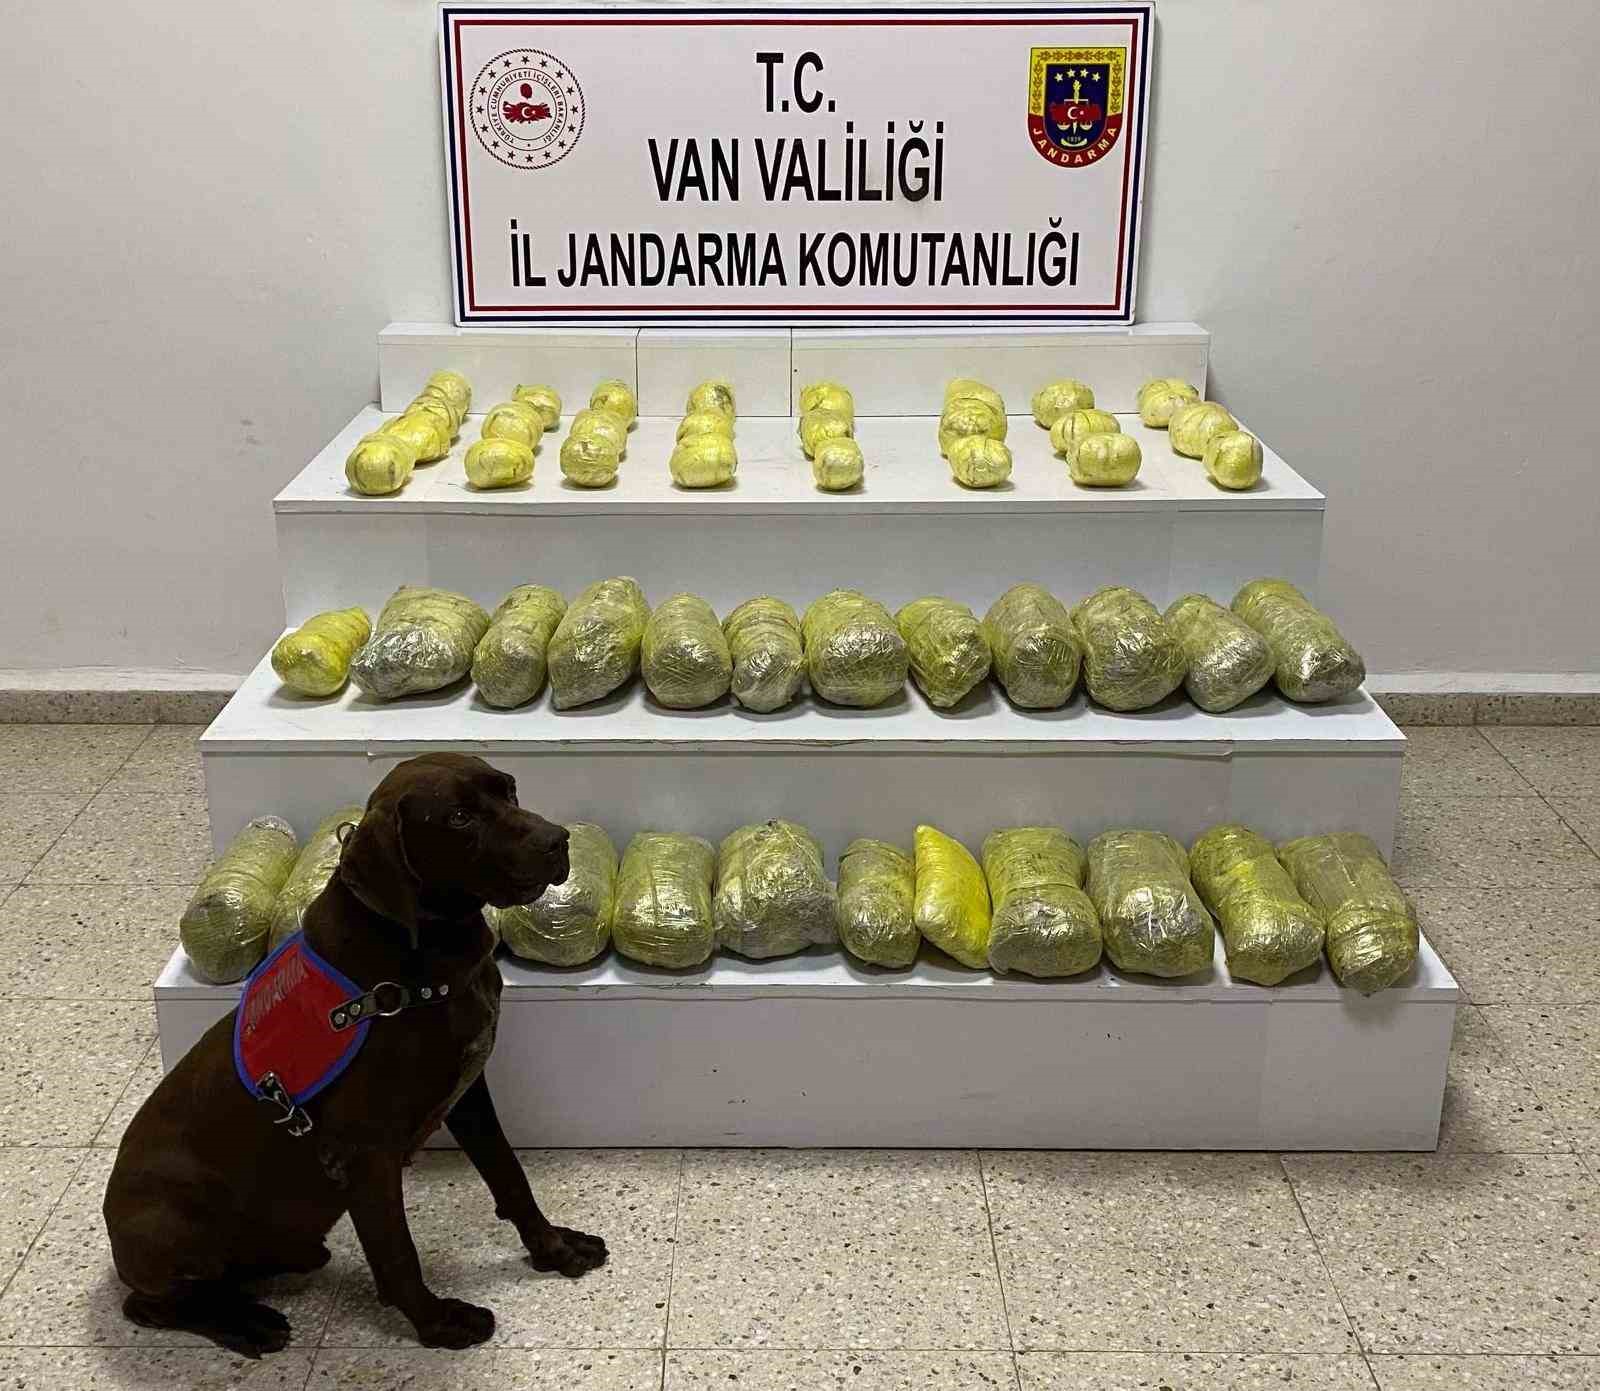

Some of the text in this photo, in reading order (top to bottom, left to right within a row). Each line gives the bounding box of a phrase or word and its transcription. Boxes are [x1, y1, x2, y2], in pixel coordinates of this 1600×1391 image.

[490, 71, 531, 110] CUMHURİYETİ
[757, 52, 835, 113] T.C.
[648, 120, 944, 203] VAN VALİLİĞİ
[1033, 127, 1117, 164] JANDARMA
[511, 217, 1080, 288] İL JANDARMA KOMUTANLIĞI
